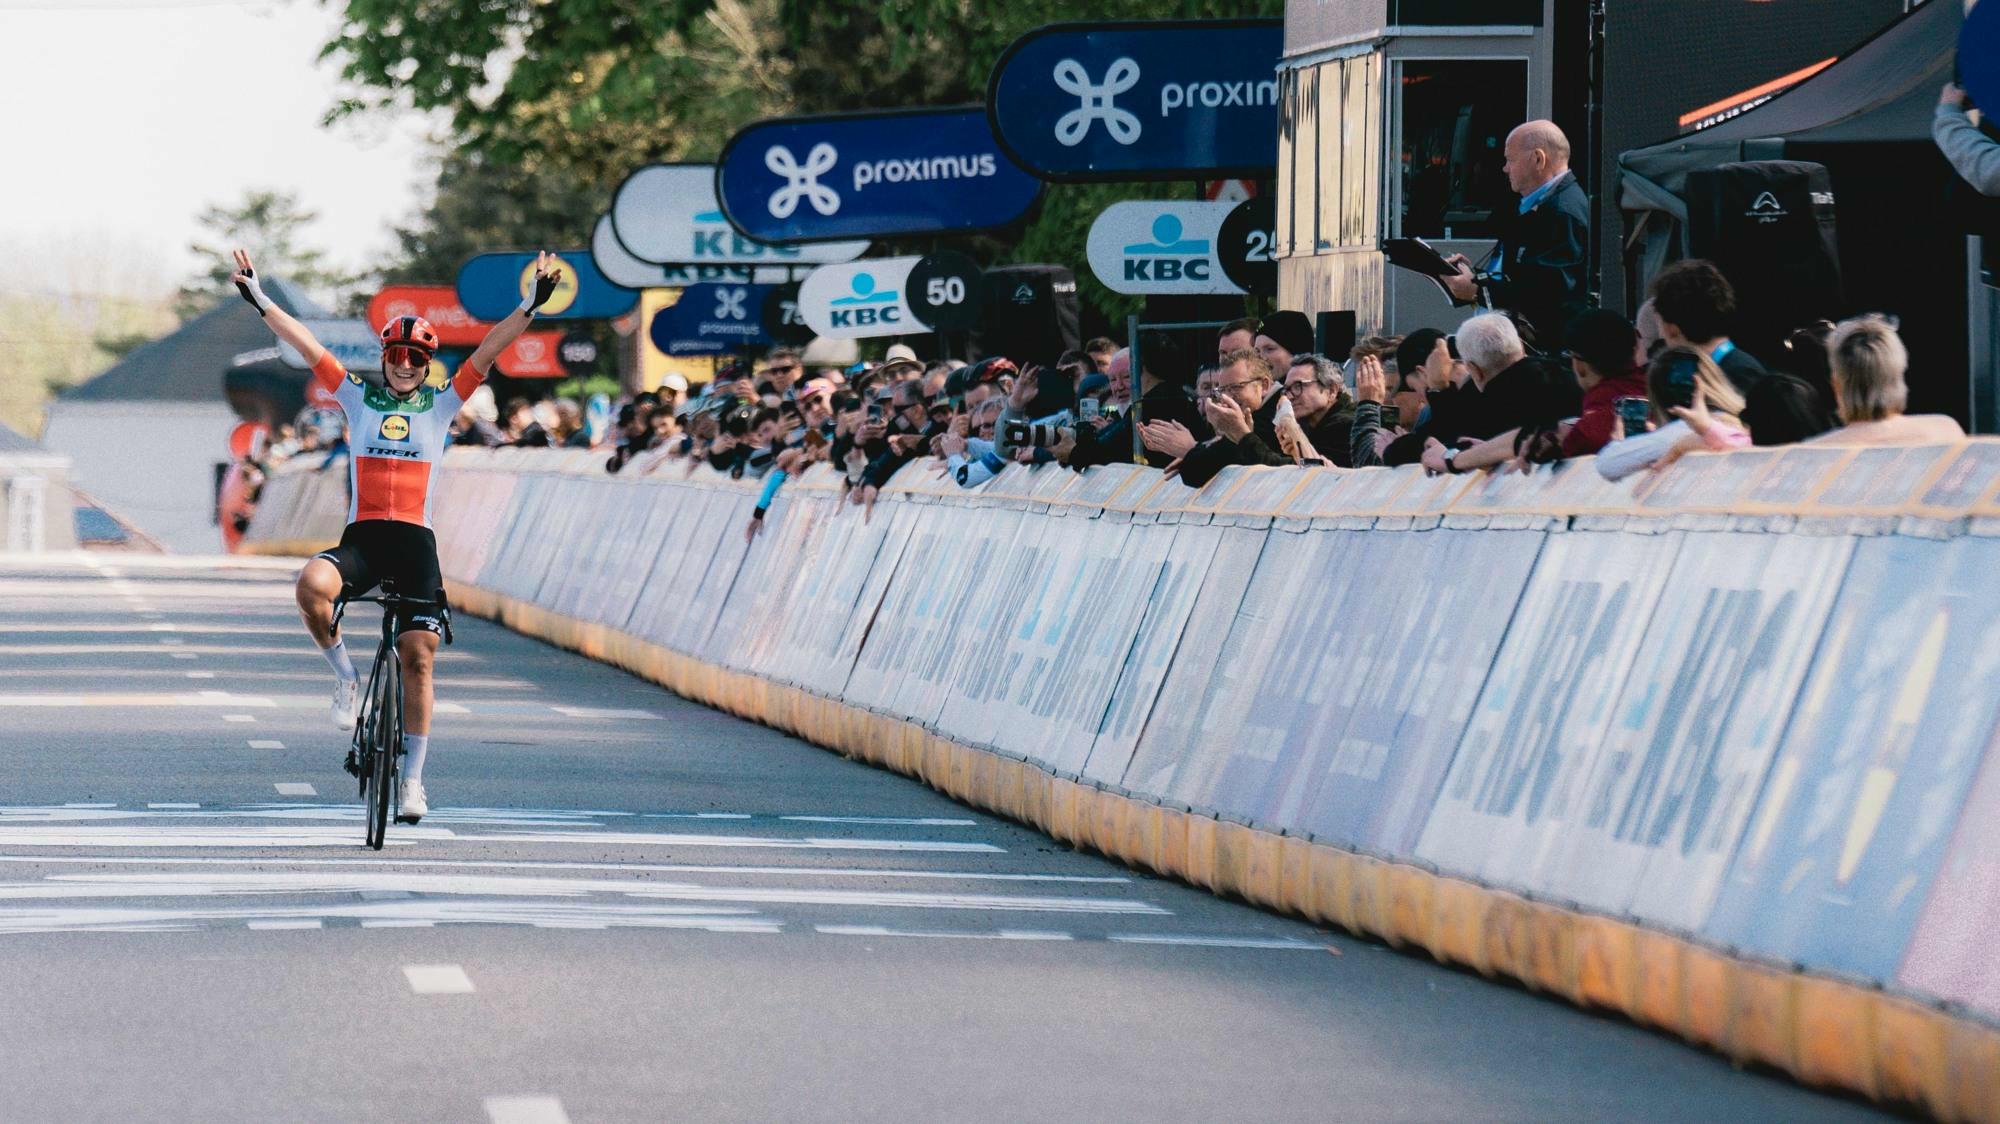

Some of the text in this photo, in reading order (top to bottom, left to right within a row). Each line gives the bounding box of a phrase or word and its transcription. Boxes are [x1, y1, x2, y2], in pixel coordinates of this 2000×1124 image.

[853, 153, 997, 192] proximus
[694, 231, 800, 257] KB
[1245, 230, 1276, 262] 2
[1124, 259, 1210, 281] KBC
[926, 276, 966, 306] 50
[830, 306, 900, 329] KBC
[366, 446, 421, 458] TREK
